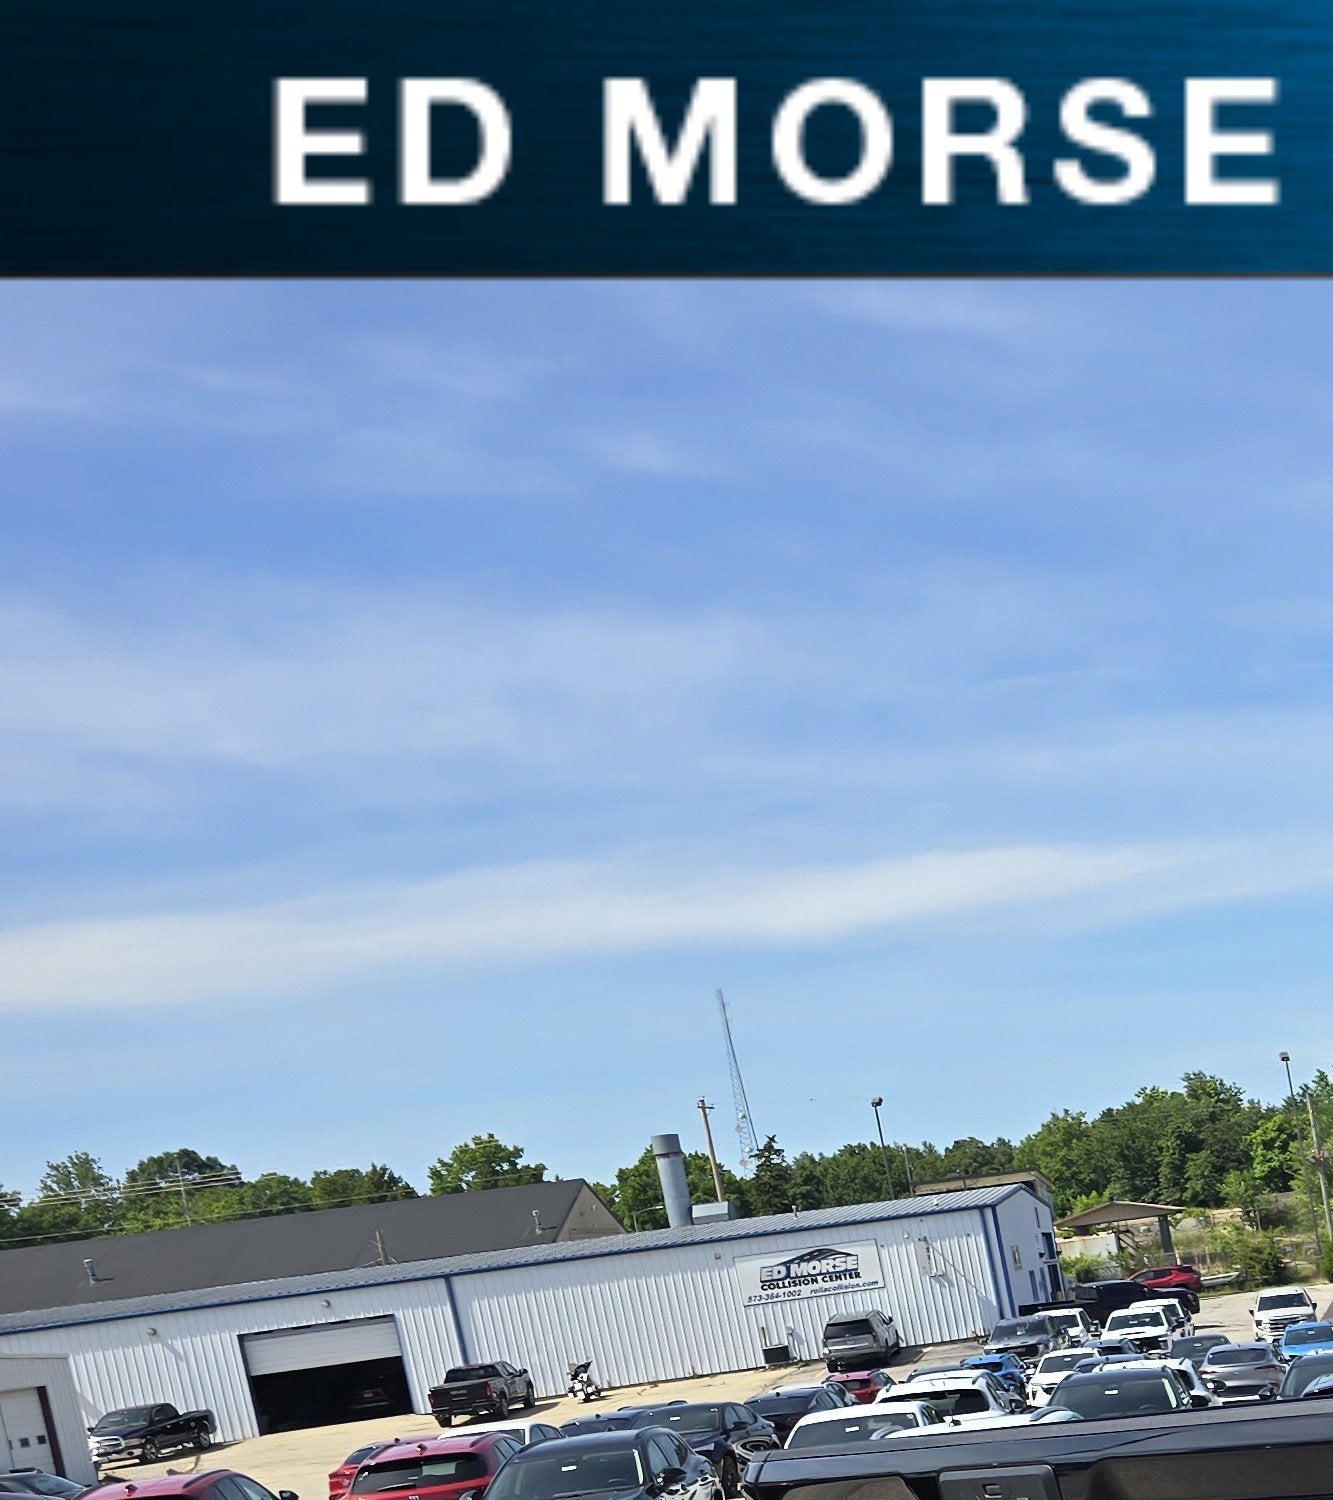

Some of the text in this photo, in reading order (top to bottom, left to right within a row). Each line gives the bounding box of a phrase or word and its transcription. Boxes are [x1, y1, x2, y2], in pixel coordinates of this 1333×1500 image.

[760, 1254, 859, 1282] ED MORSE
[760, 1270, 862, 1292] COLLISION CENTER
[748, 1289, 802, 1304] 573-364-1002
